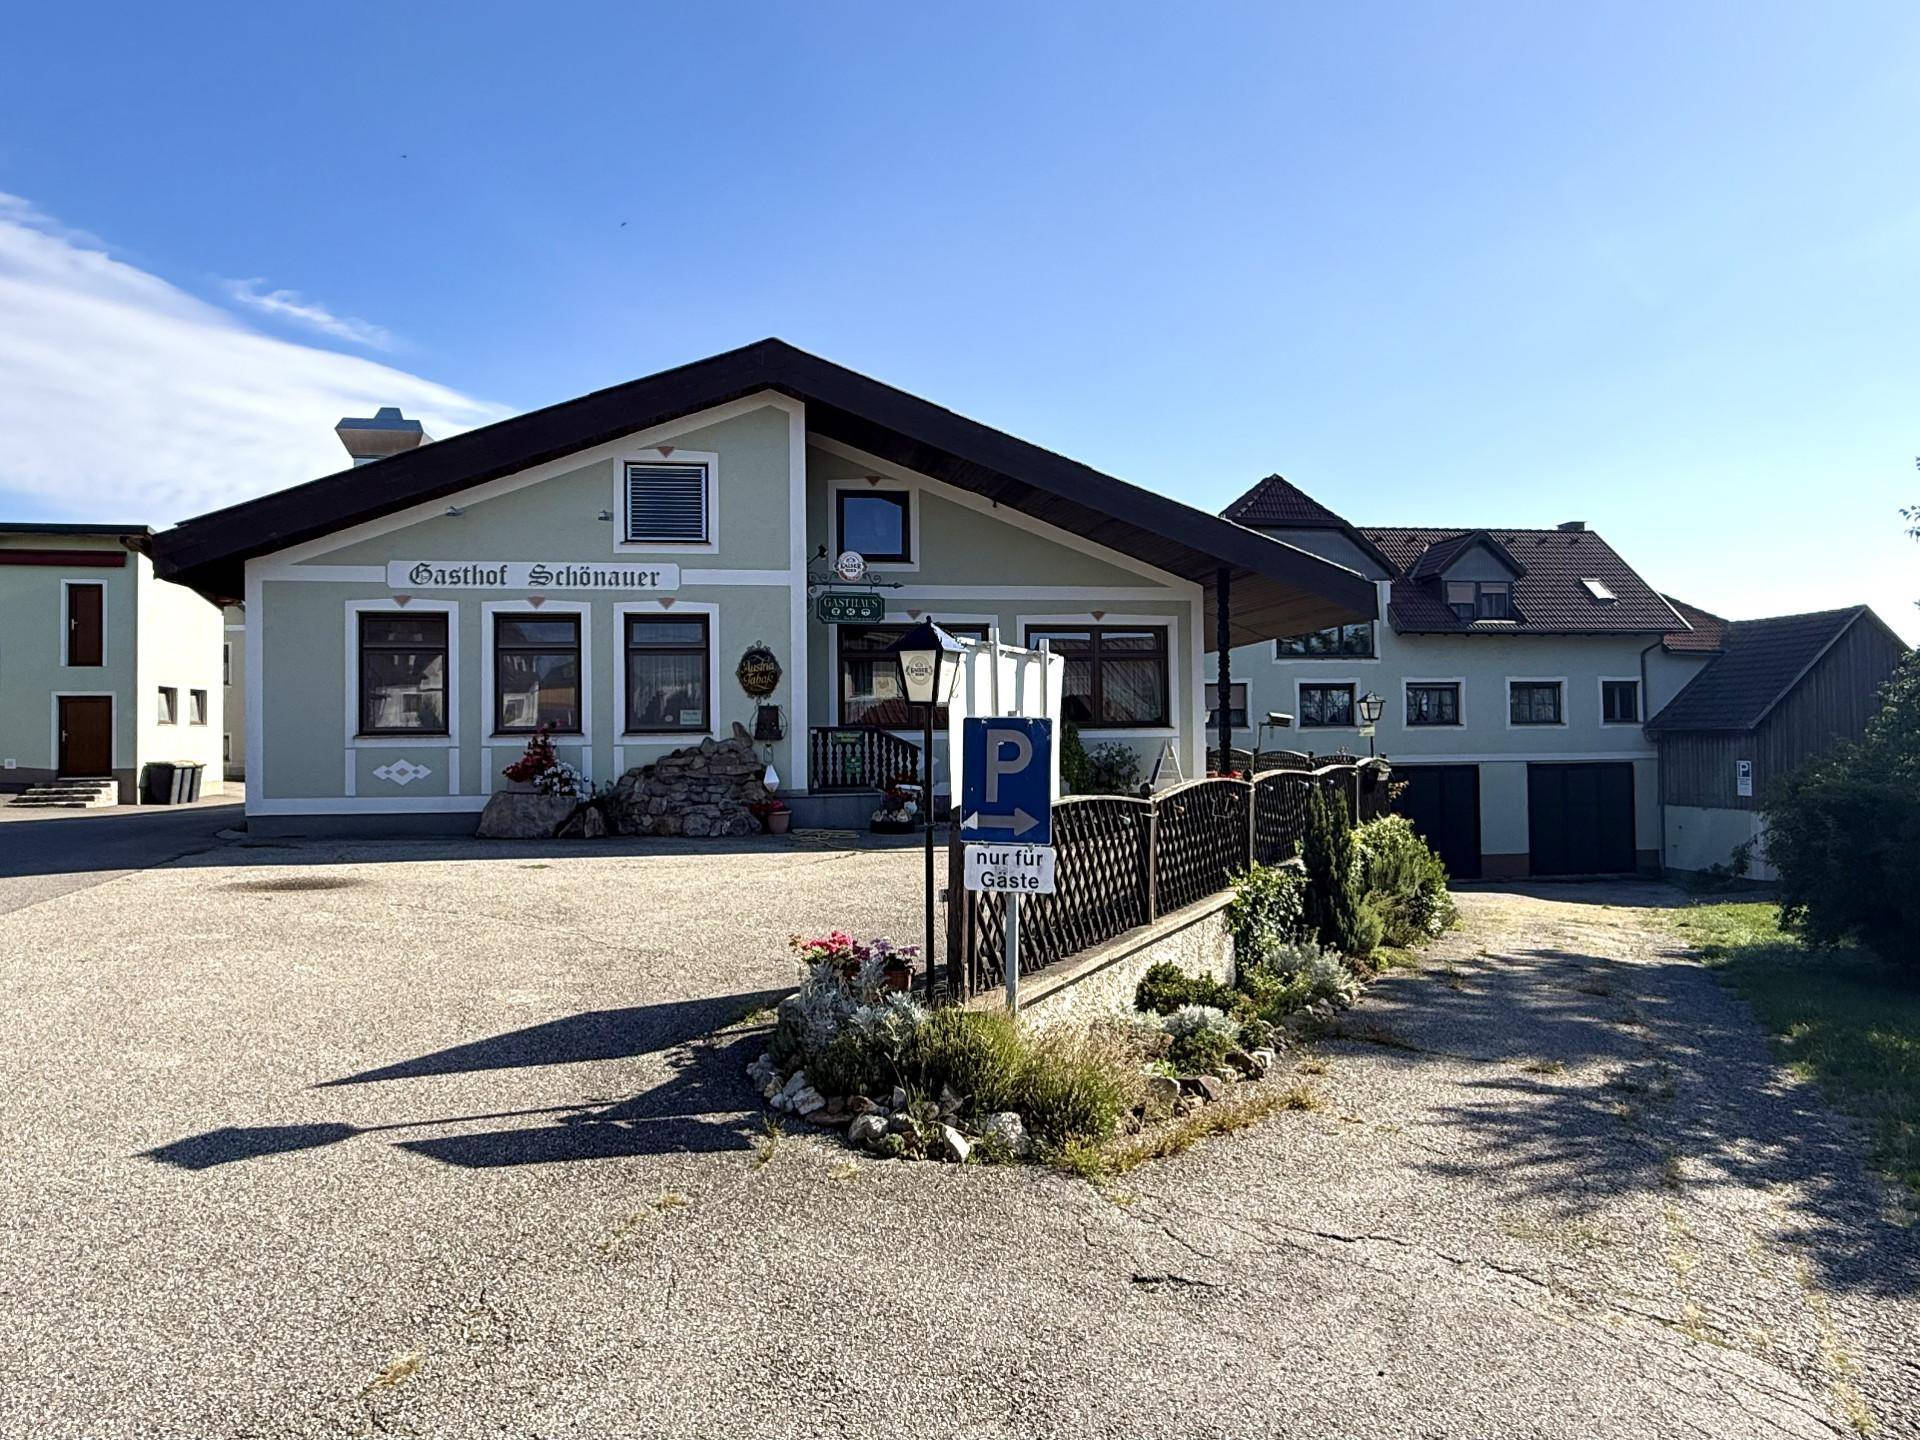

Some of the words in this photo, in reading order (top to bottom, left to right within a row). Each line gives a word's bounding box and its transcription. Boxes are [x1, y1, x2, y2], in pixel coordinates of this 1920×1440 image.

[408, 562, 508, 588] Gasthof
[527, 563, 661, 588] Schönauer
[823, 597, 878, 608] GASTHAUS
[741, 658, 776, 673] Austria
[985, 728, 1033, 803] P
[1740, 763, 1749, 777] P
[976, 852, 1010, 866] nur
[1015, 850, 1044, 867] für
[980, 871, 1040, 889] Gäste
